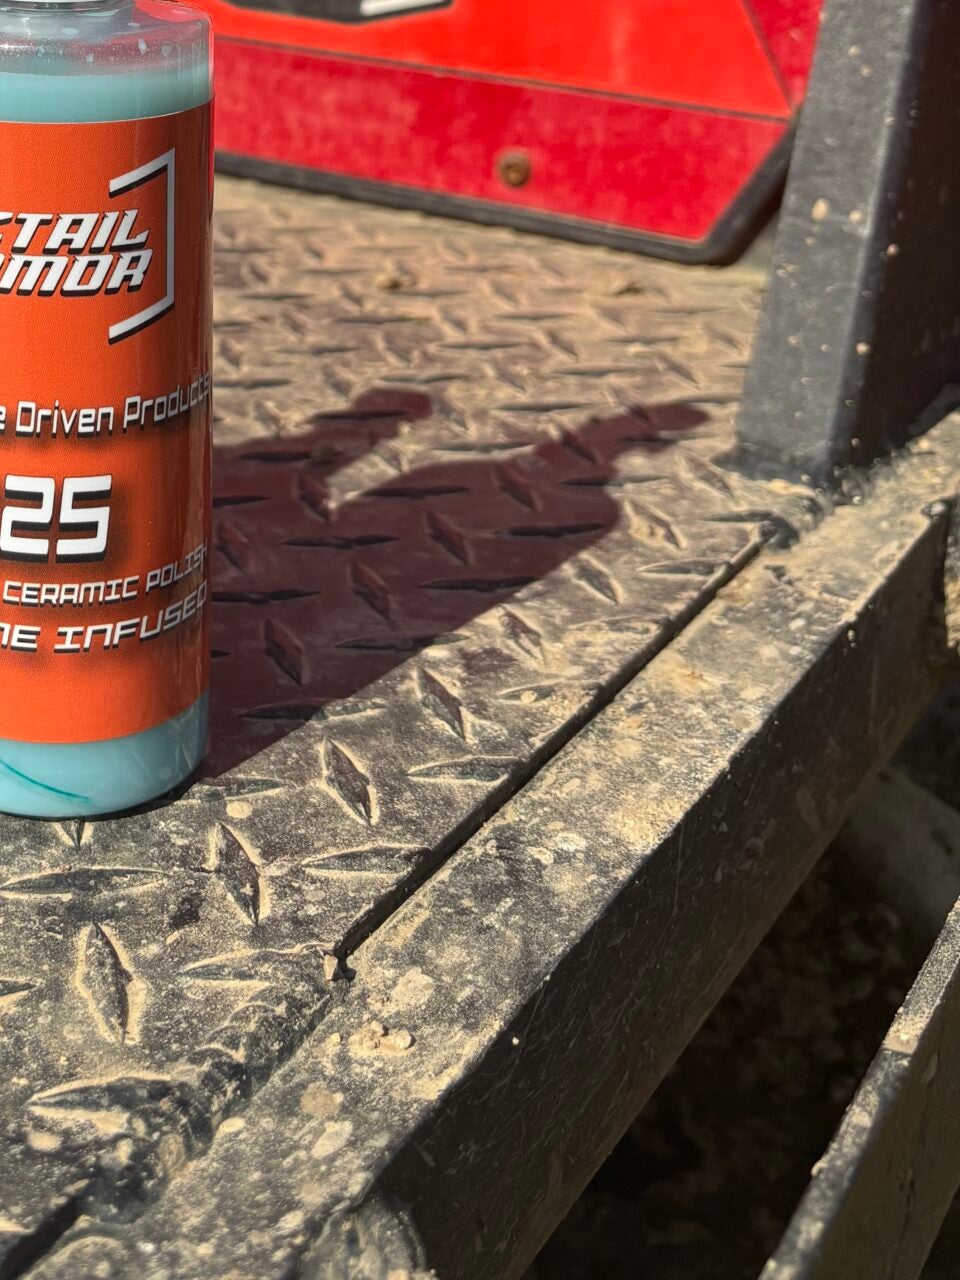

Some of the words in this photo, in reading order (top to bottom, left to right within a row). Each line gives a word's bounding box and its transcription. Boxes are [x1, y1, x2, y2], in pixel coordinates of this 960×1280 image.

[15, 400, 114, 437] Driven
[2, 575, 139, 608] CERAMIC
[145, 537, 207, 594] POLISH
[54, 579, 207, 653] INFUSED
